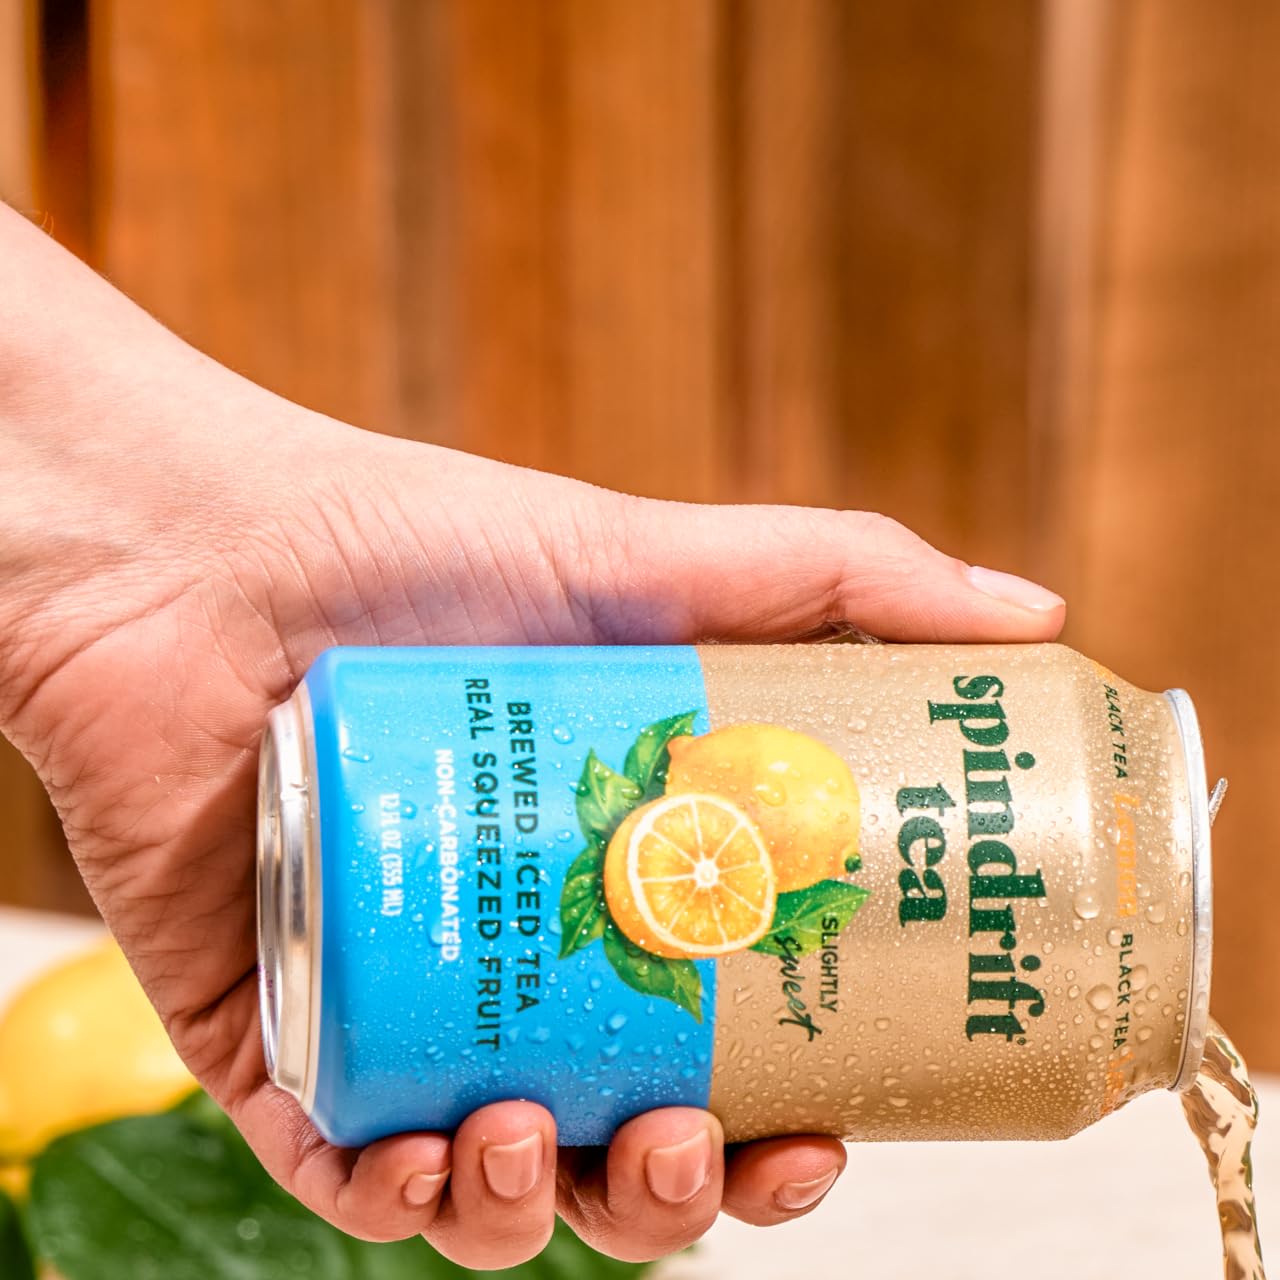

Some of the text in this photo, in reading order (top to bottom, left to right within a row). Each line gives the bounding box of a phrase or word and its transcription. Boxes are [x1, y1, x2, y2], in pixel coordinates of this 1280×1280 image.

[1103, 683, 1129, 779] BLACK TEA
[380, 793, 400, 808] 12
[382, 830, 402, 850] OZ
[380, 852, 403, 886] (355
[381, 888, 403, 917] ML)
[435, 748, 461, 962] NON-CARBONATED
[464, 678, 502, 1052] REAL SQUEEZED FRUIT
[506, 701, 541, 1013] BREWED ICED TEA
[895, 782, 957, 927] tea
[928, 675, 1047, 1042] spindrift
[773, 935, 823, 1042] sweet
[819, 917, 839, 1013] SLIGHTLY
[1117, 933, 1134, 1007] BLACK
[1112, 1012, 1129, 1050] TEA
